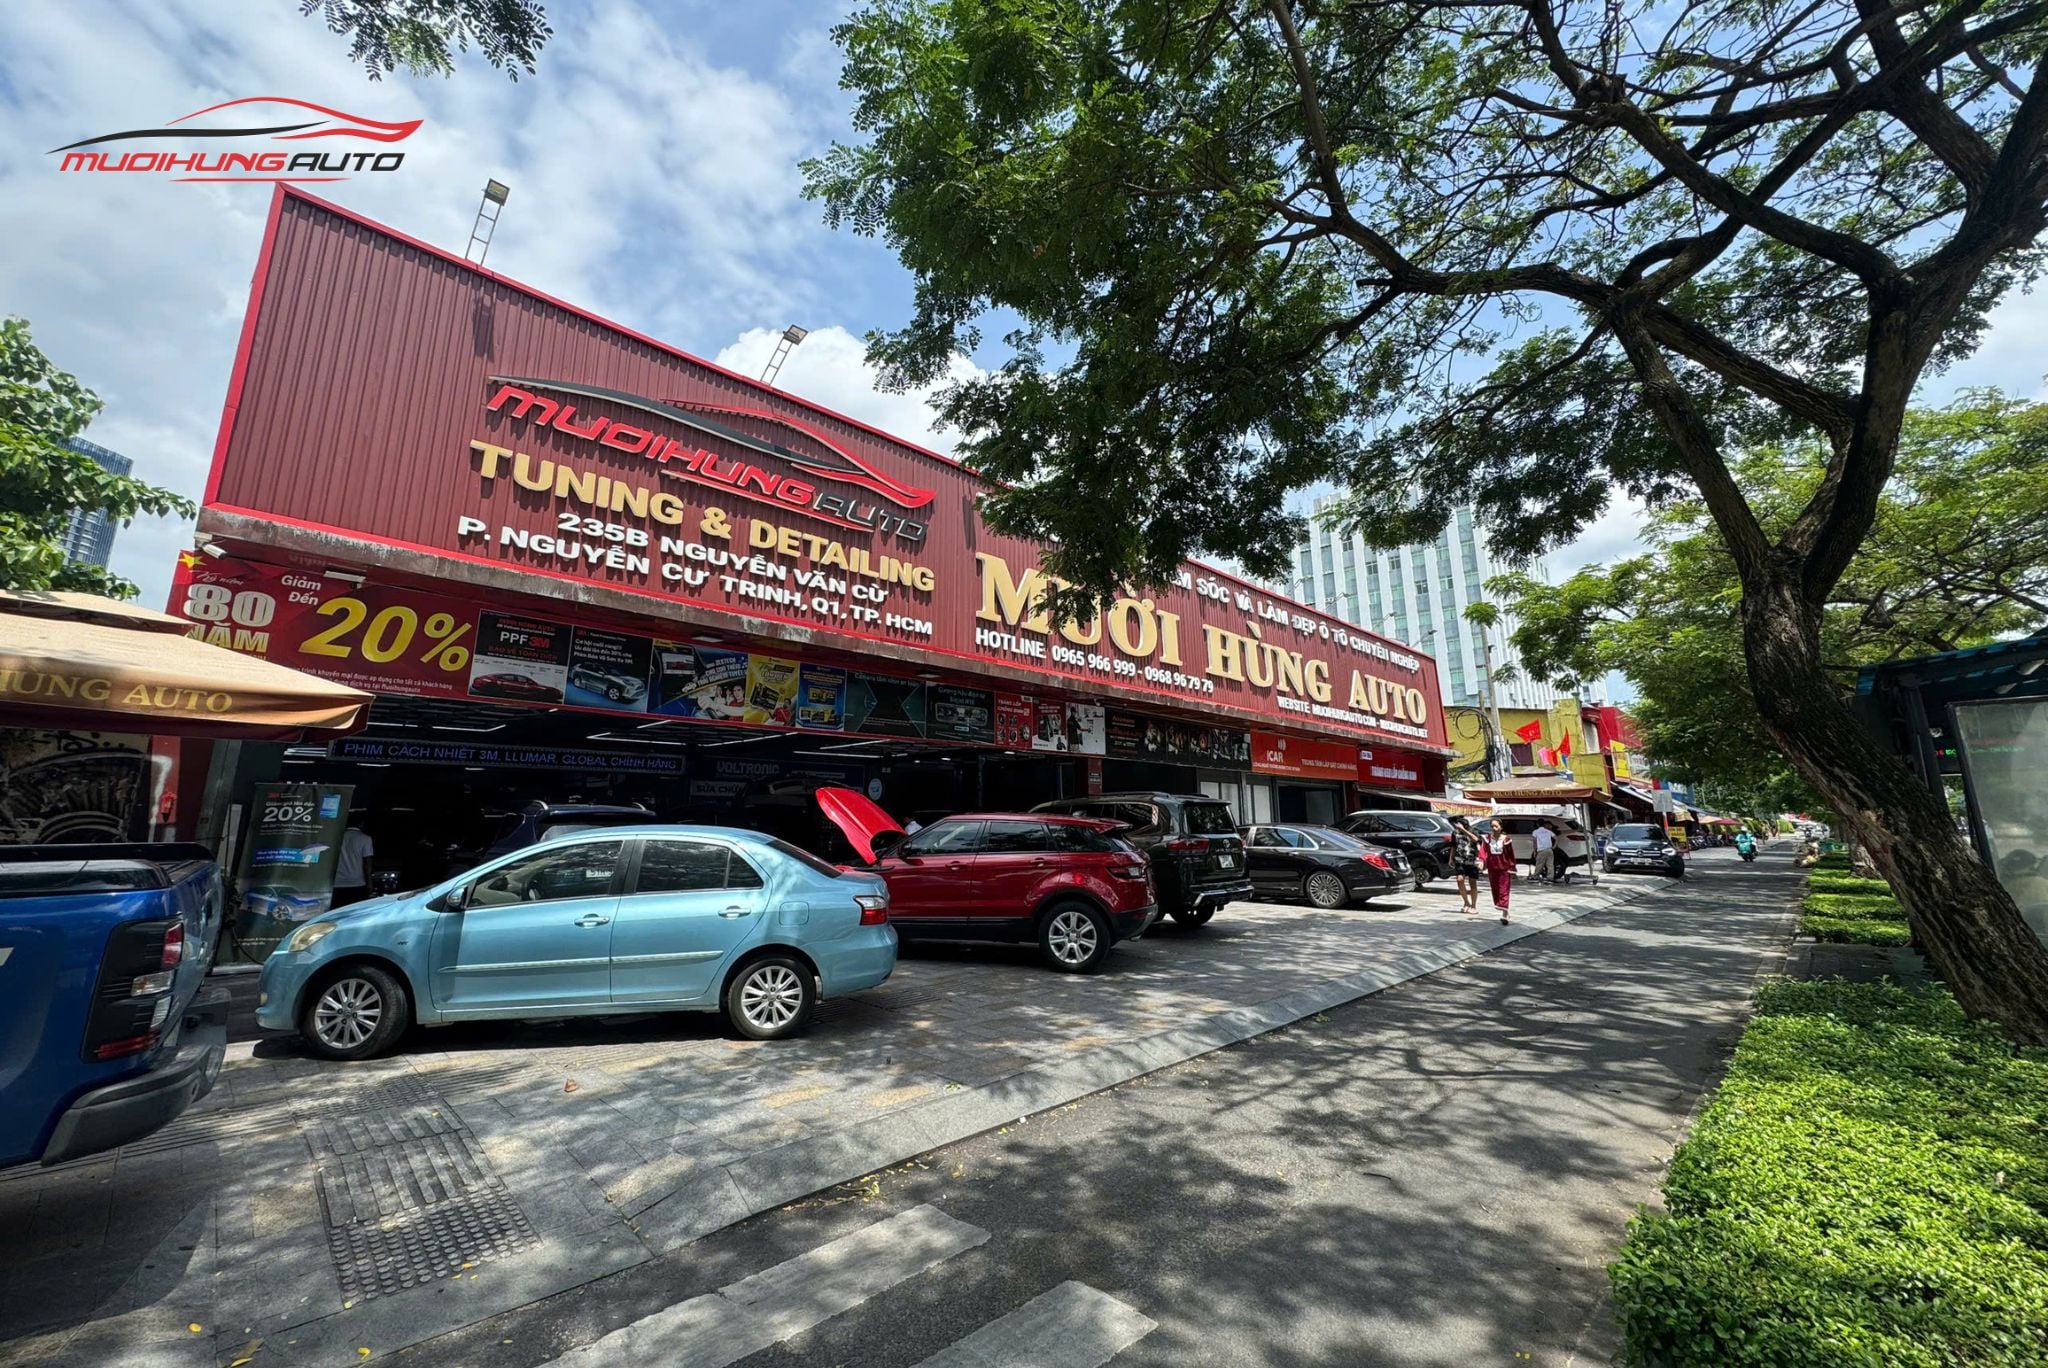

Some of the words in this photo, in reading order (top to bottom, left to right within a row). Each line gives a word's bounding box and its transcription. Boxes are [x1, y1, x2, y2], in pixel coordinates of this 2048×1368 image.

[487, 384, 928, 541] MUOIHUNGAUTO
[469, 439, 685, 526] TUNING
[700, 506, 733, 540] &
[749, 518, 936, 593] DETAILING
[456, 516, 492, 541] P.
[500, 526, 650, 576] NGUYỄN
[718, 573, 808, 611] TRINH,
[885, 612, 933, 635] HCM
[557, 511, 649, 549] 235B
[660, 534, 786, 582] NGUYỄN
[793, 568, 847, 595] VĂN
[851, 583, 889, 603] CỪ
[281, 574, 322, 592] Giảm
[288, 591, 319, 606] Đến
[183, 583, 276, 628] 80
[1196, 576, 1231, 604] SÓC
[1233, 589, 1256, 614] VÀ
[1257, 599, 1289, 626] LÀM
[1291, 614, 1317, 636] ĐẸP
[1318, 621, 1330, 640] Ô
[1330, 627, 1349, 647] TÔ
[1349, 635, 1390, 662] CHUYÊN
[298, 596, 473, 672] 20%
[499, 631, 529, 645] PPF
[528, 635, 551, 649] 3M
[1051, 645, 1086, 667] 0965
[1087, 654, 1111, 672] 966
[1113, 659, 1136, 678] 999
[1144, 665, 1172, 685] 0968
[1202, 622, 1334, 703] HÙNG
[1348, 668, 1428, 725] AUTO
[122, 683, 233, 713] AUTO
[344, 742, 383, 755] PHIM
[387, 744, 430, 758] CÁCH
[433, 746, 477, 760] NHIỆT
[562, 754, 609, 766] GLOBAL
[1266, 749, 1284, 764] ICAR
[262, 806, 314, 822] 20%
